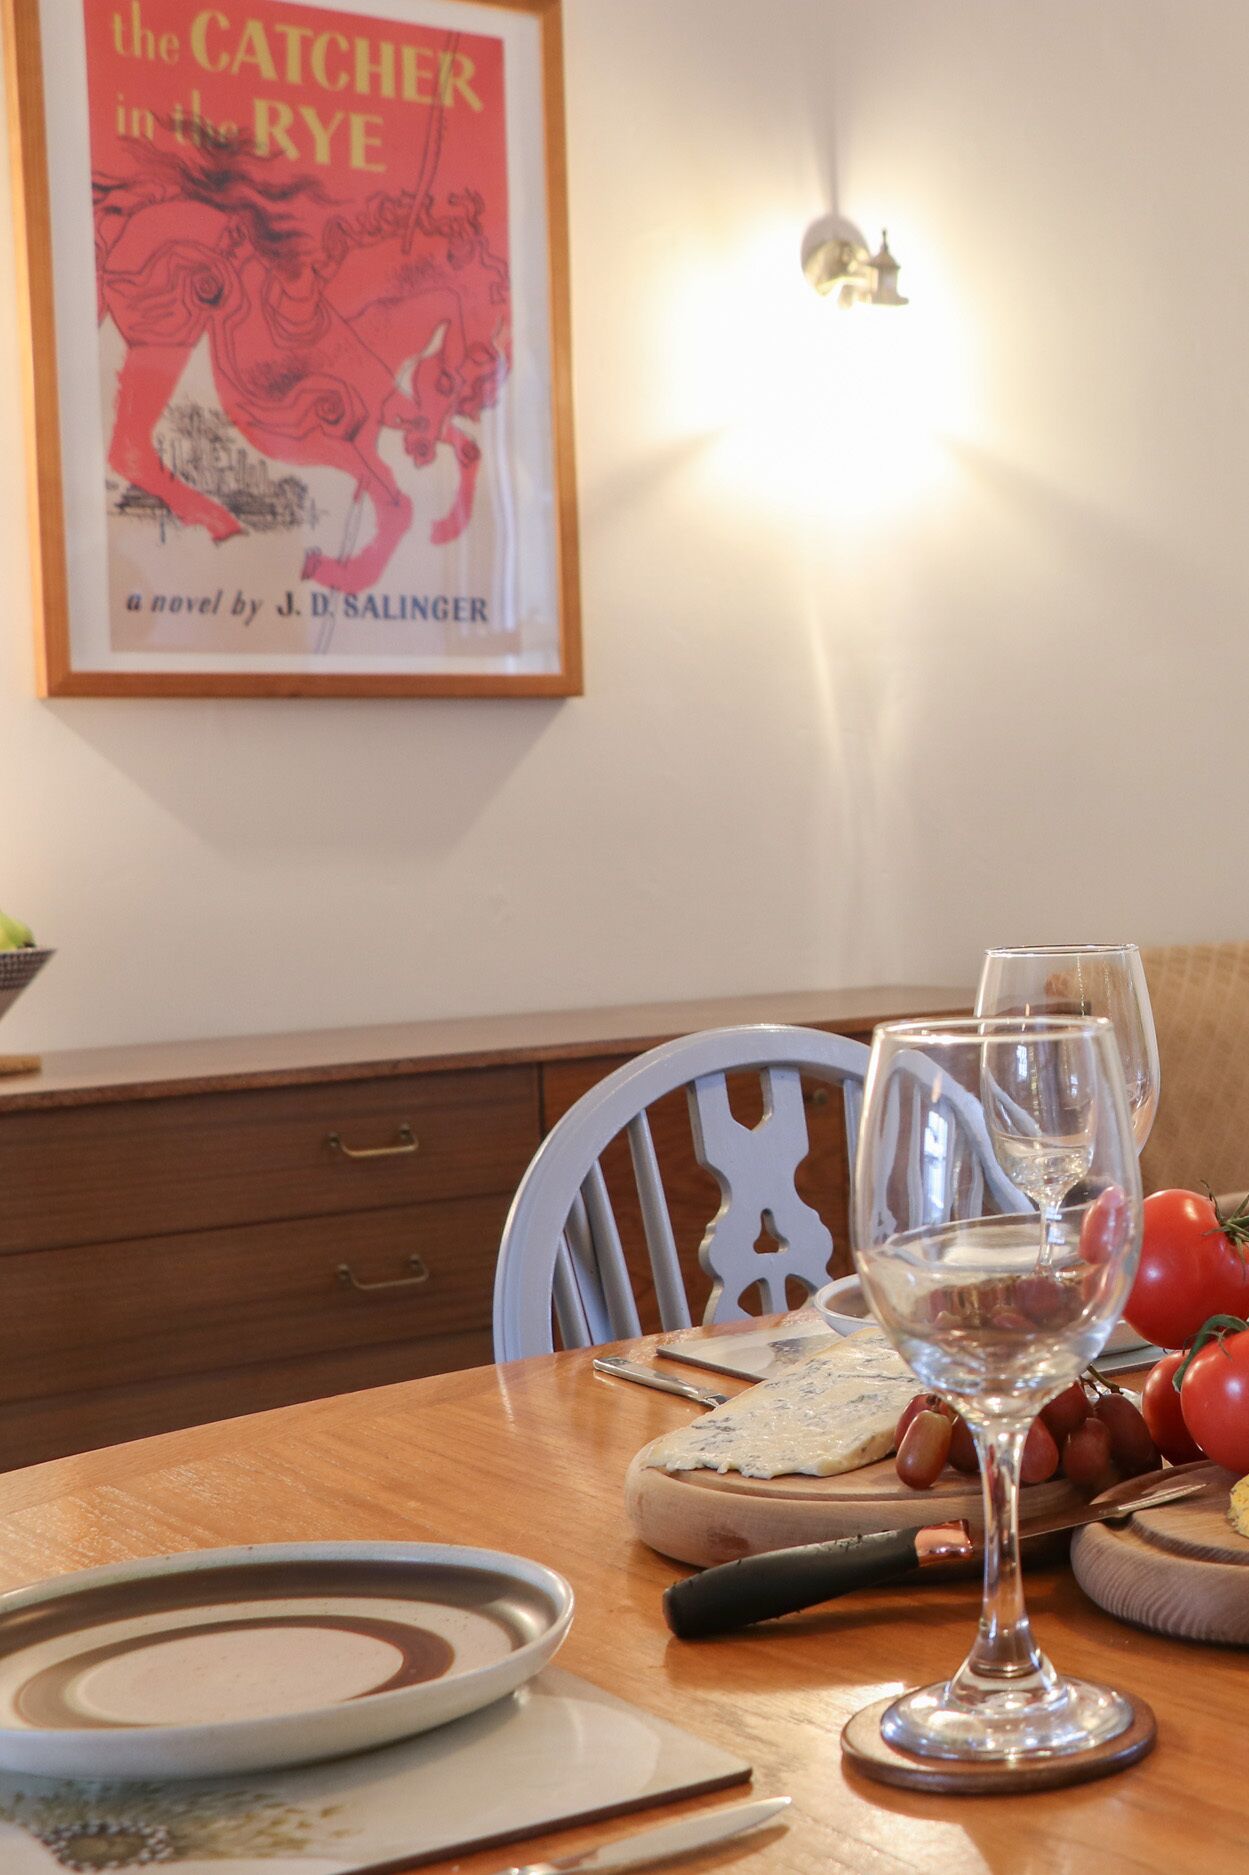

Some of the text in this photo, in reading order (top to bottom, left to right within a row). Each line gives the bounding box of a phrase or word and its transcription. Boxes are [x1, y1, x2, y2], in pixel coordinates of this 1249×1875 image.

[112, 0, 484, 112] the CATCHER
[116, 92, 155, 141] in
[252, 97, 388, 174] RYE
[126, 589, 488, 626] a novel by J. D. SALINGER
